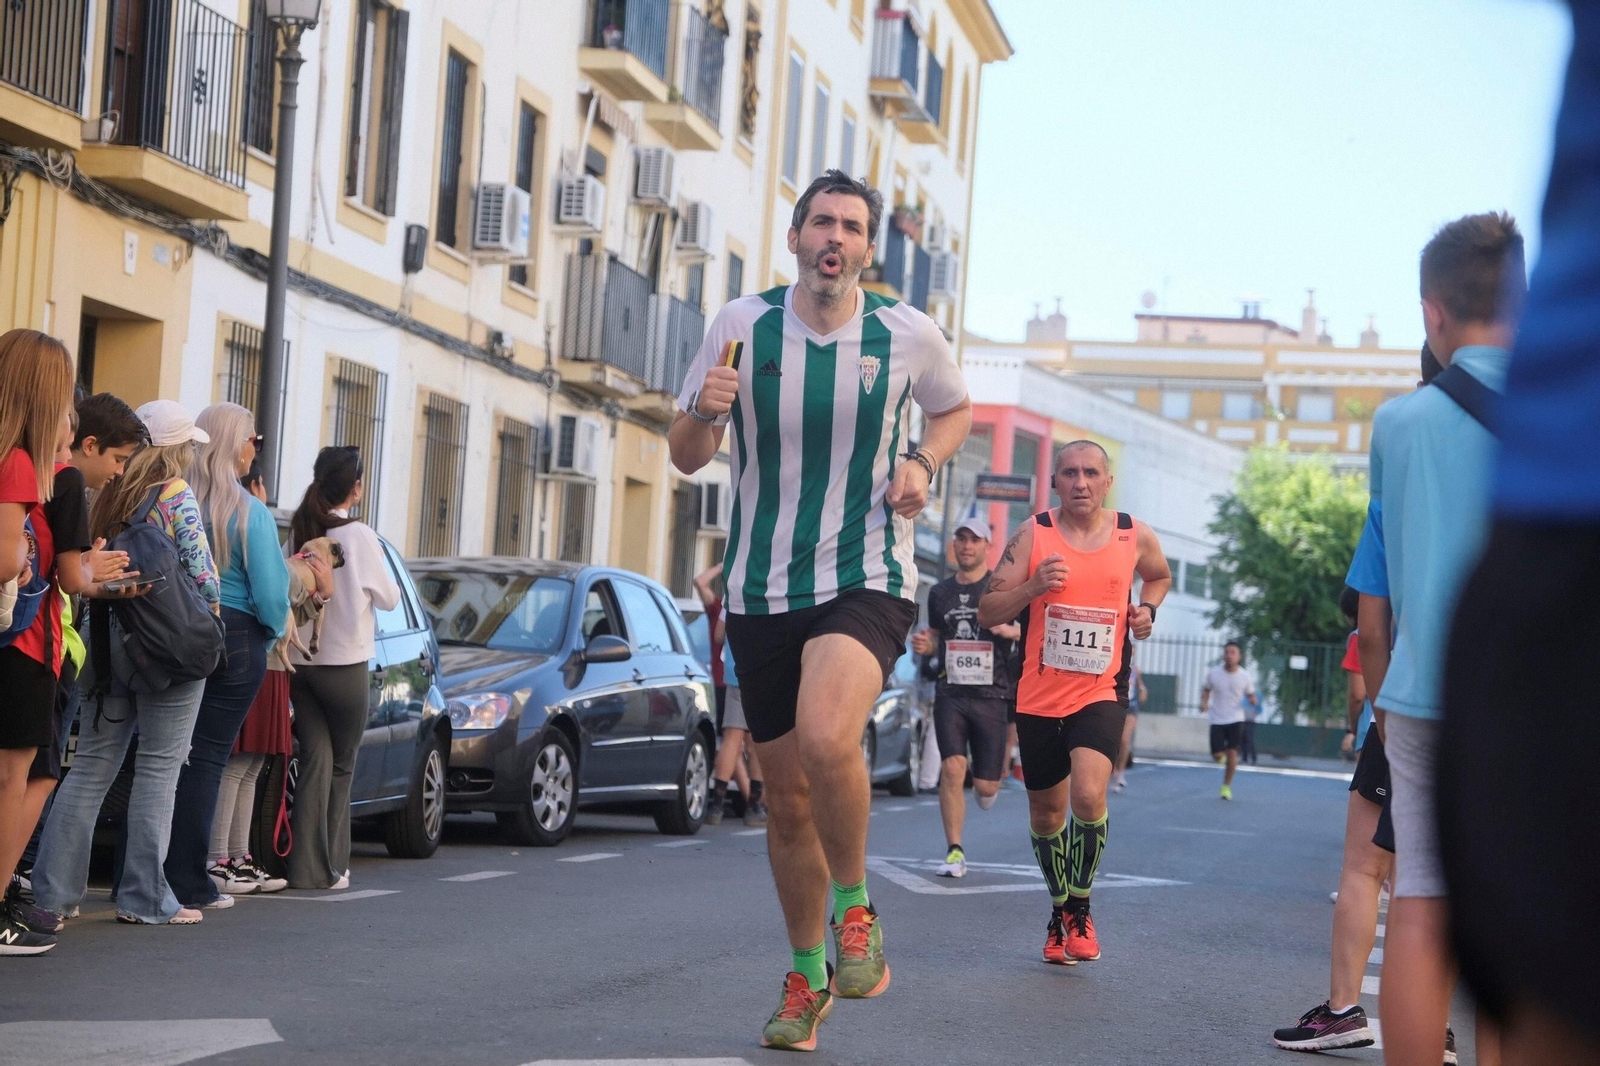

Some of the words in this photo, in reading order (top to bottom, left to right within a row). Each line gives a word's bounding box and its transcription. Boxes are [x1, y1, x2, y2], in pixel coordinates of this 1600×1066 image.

[756, 368, 782, 377] adidas
[1061, 628, 1098, 649] 111
[956, 656, 981, 668] 684
